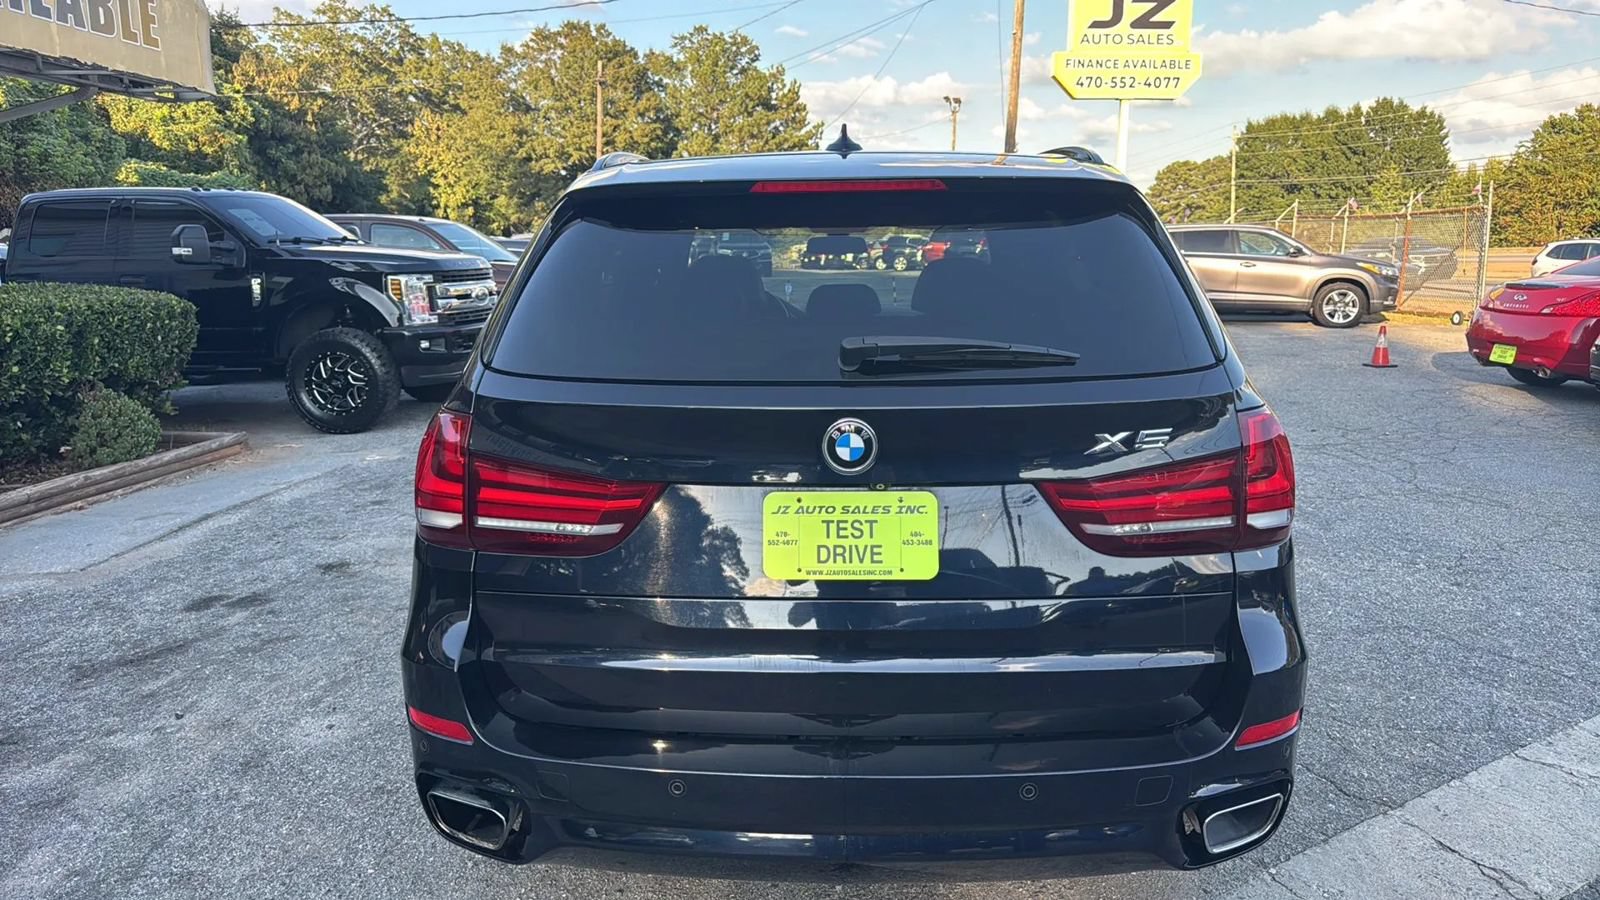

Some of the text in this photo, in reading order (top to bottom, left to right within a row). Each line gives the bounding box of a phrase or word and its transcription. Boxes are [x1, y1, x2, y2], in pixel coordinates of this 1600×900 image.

[1087, 0, 1176, 29] JZ
[1080, 33, 1174, 45] AUTO SALES
[1065, 59, 1191, 70] FINANCE AVAILABLE
[1076, 76, 1181, 89] 470-552-4077
[831, 424, 870, 440] BMW
[1083, 428, 1173, 455] X5
[771, 505, 928, 514] JZ AUTO SALES INC.
[821, 519, 878, 539] TEST
[816, 544, 883, 564] DRIVE
